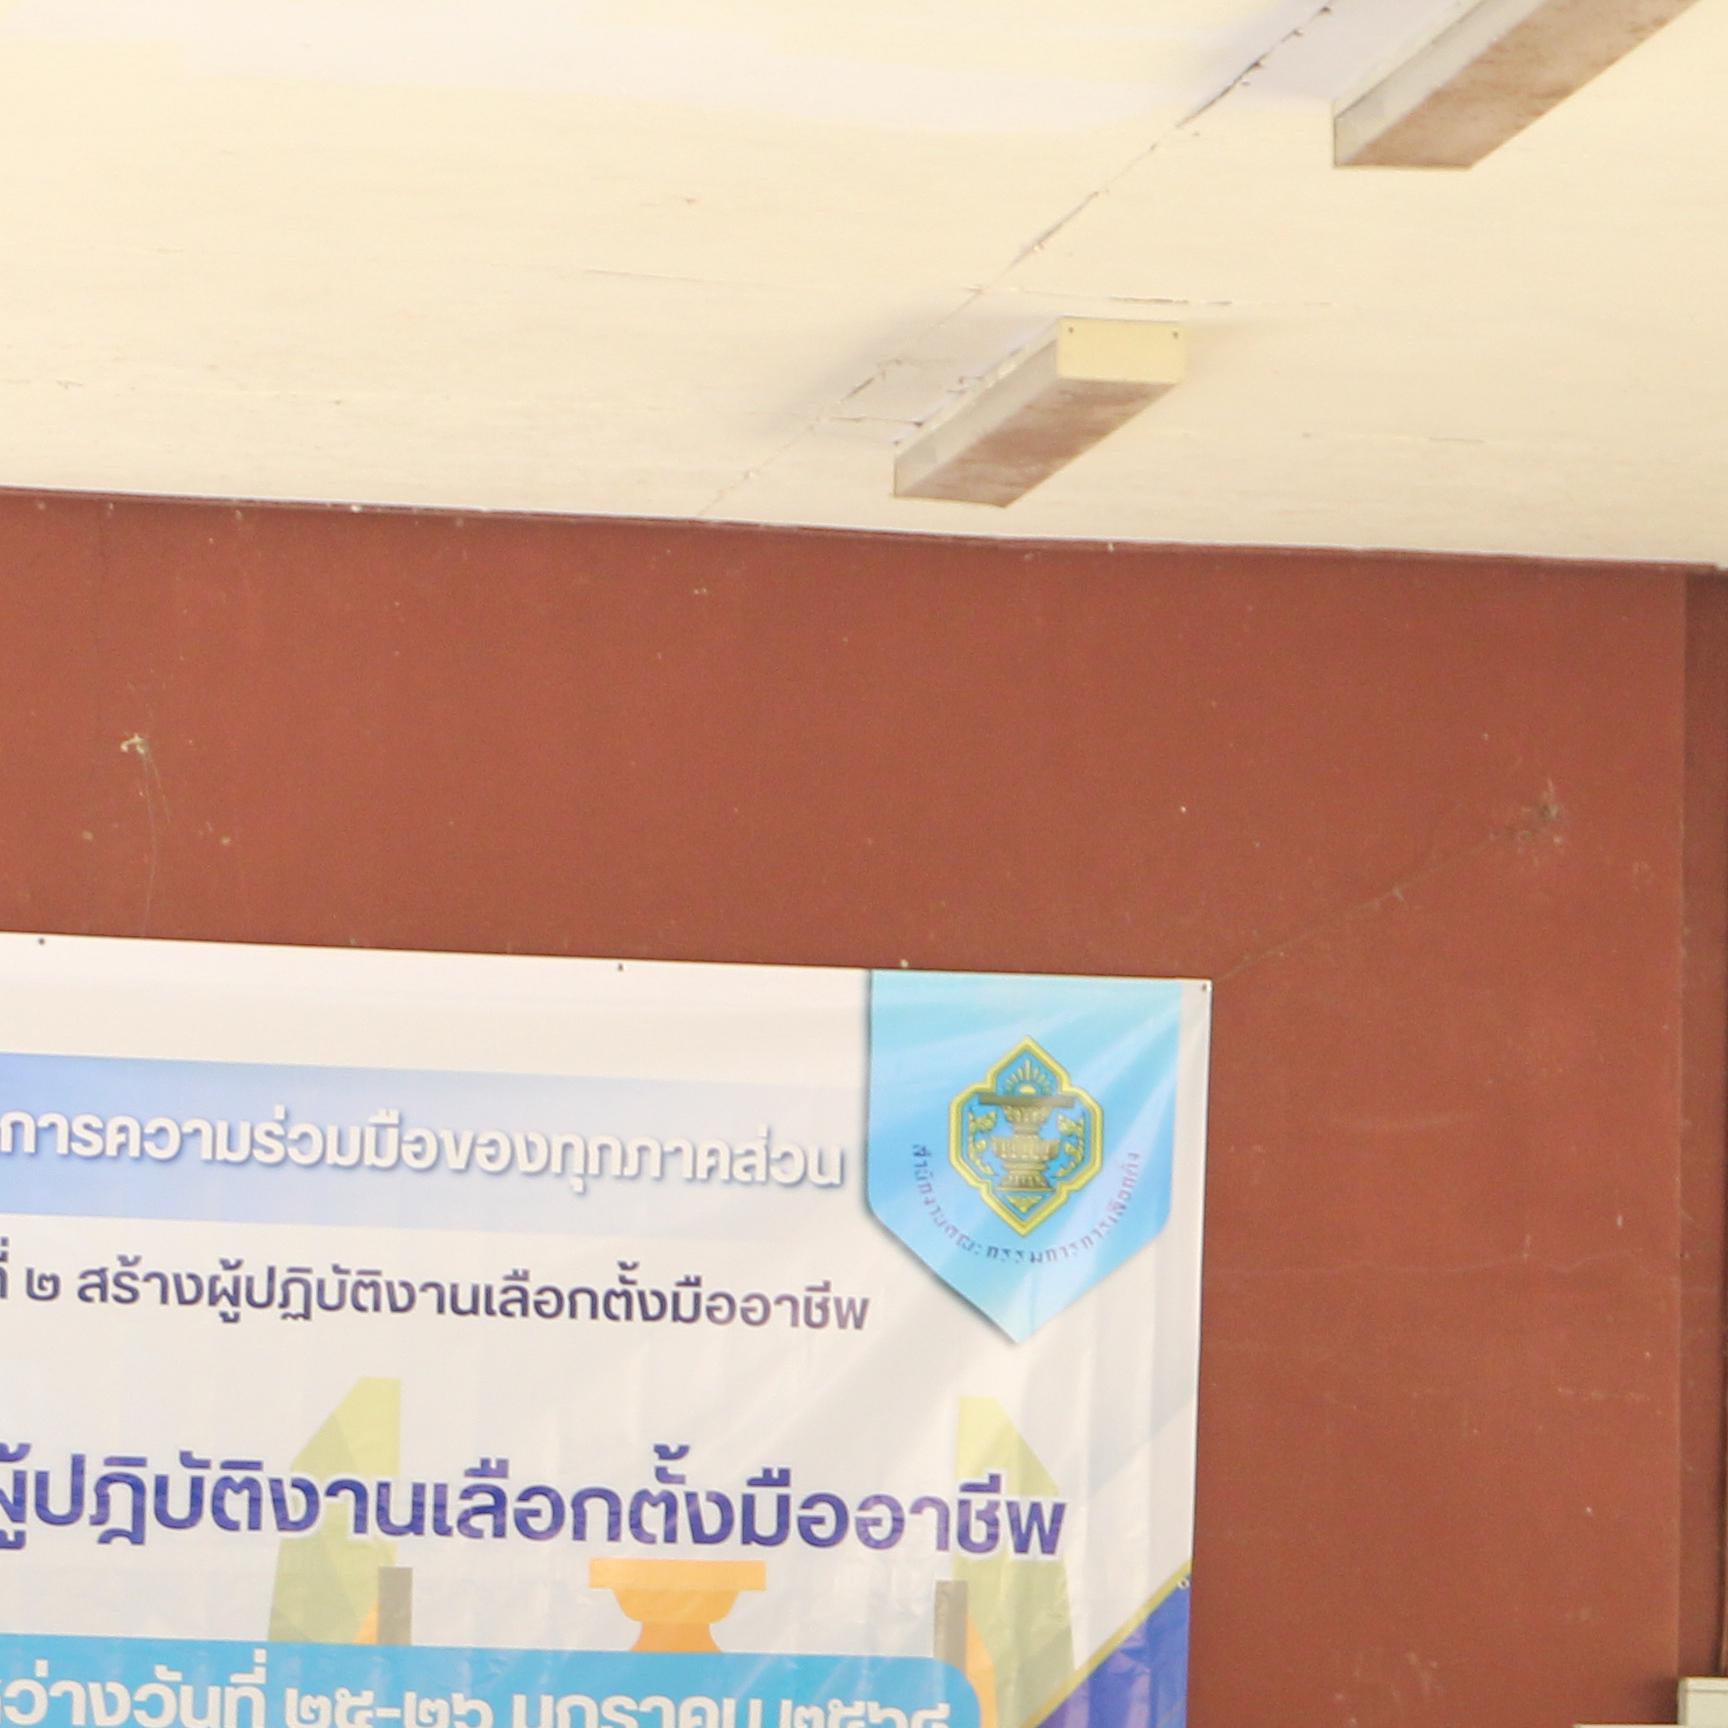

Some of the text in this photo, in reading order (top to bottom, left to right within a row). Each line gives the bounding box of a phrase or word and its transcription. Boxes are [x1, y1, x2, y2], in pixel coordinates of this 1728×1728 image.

[25, 1266, 62, 1301] ๒
[76, 1254, 870, 1330] สร้างผู้ปฏิบัติงานเลือกตั้งมืออาชีพ
